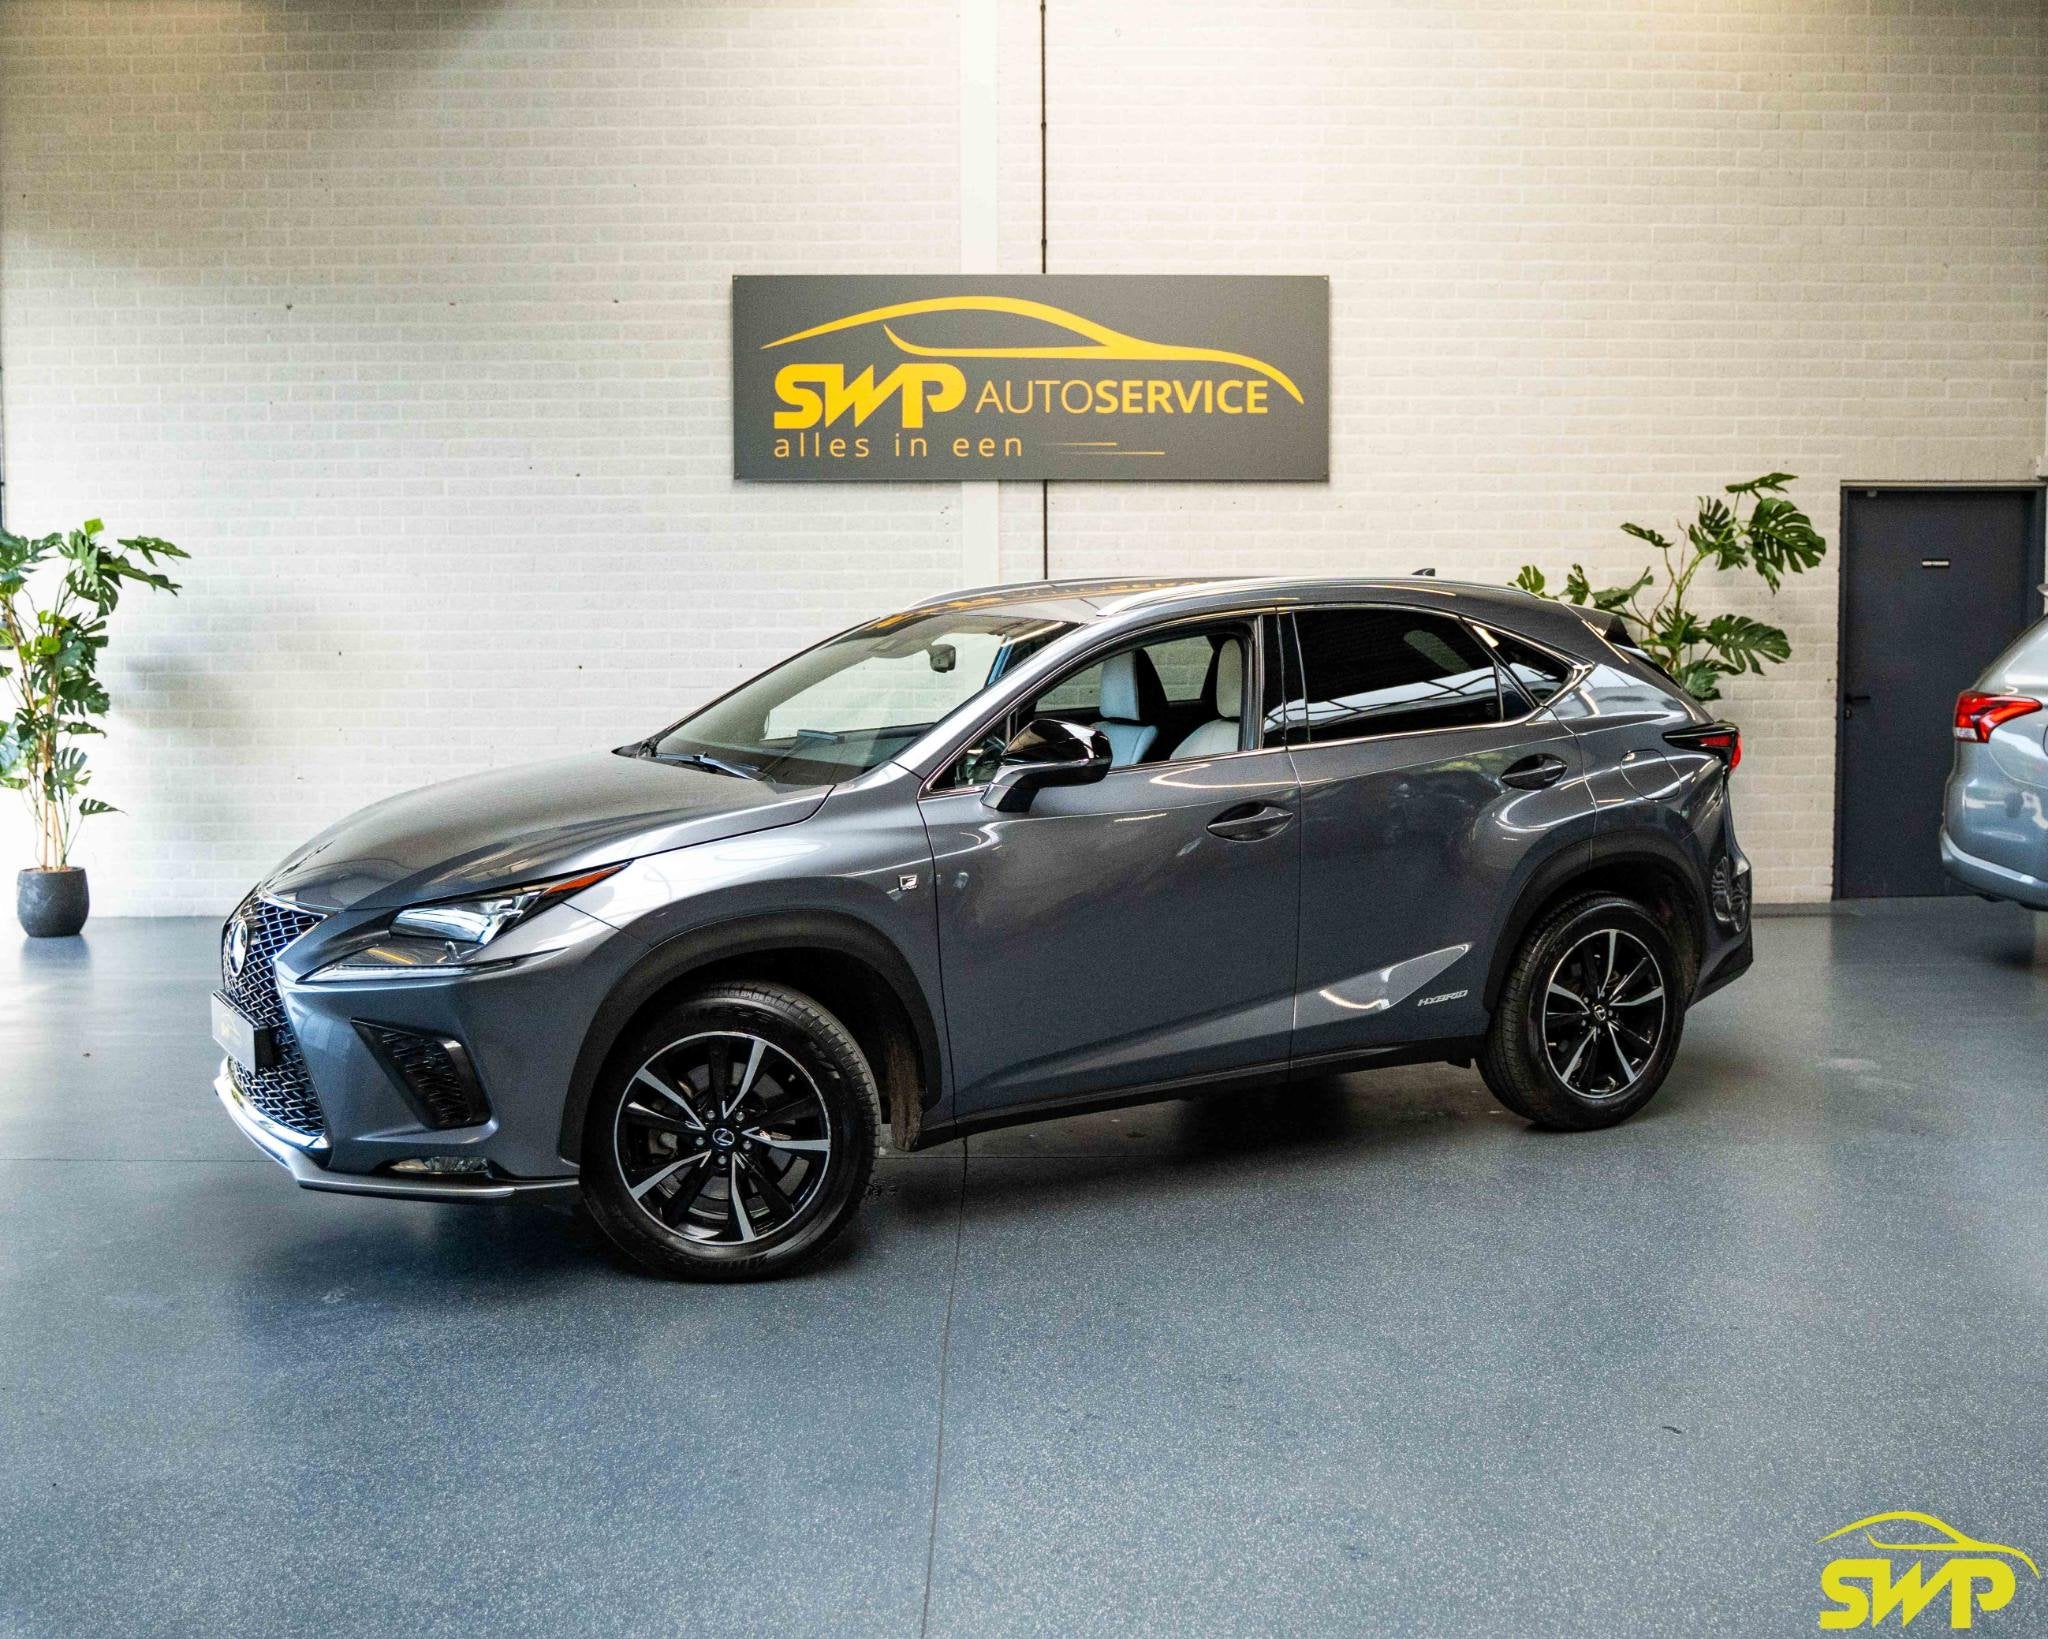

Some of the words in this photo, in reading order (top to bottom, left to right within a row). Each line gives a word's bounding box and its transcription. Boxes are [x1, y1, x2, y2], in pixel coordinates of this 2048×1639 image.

[773, 362, 968, 430] SWP
[975, 379, 1269, 415] AUTOSERVICE
[774, 432, 870, 458] alles
[895, 432, 929, 457] in
[953, 437, 1023, 458] een
